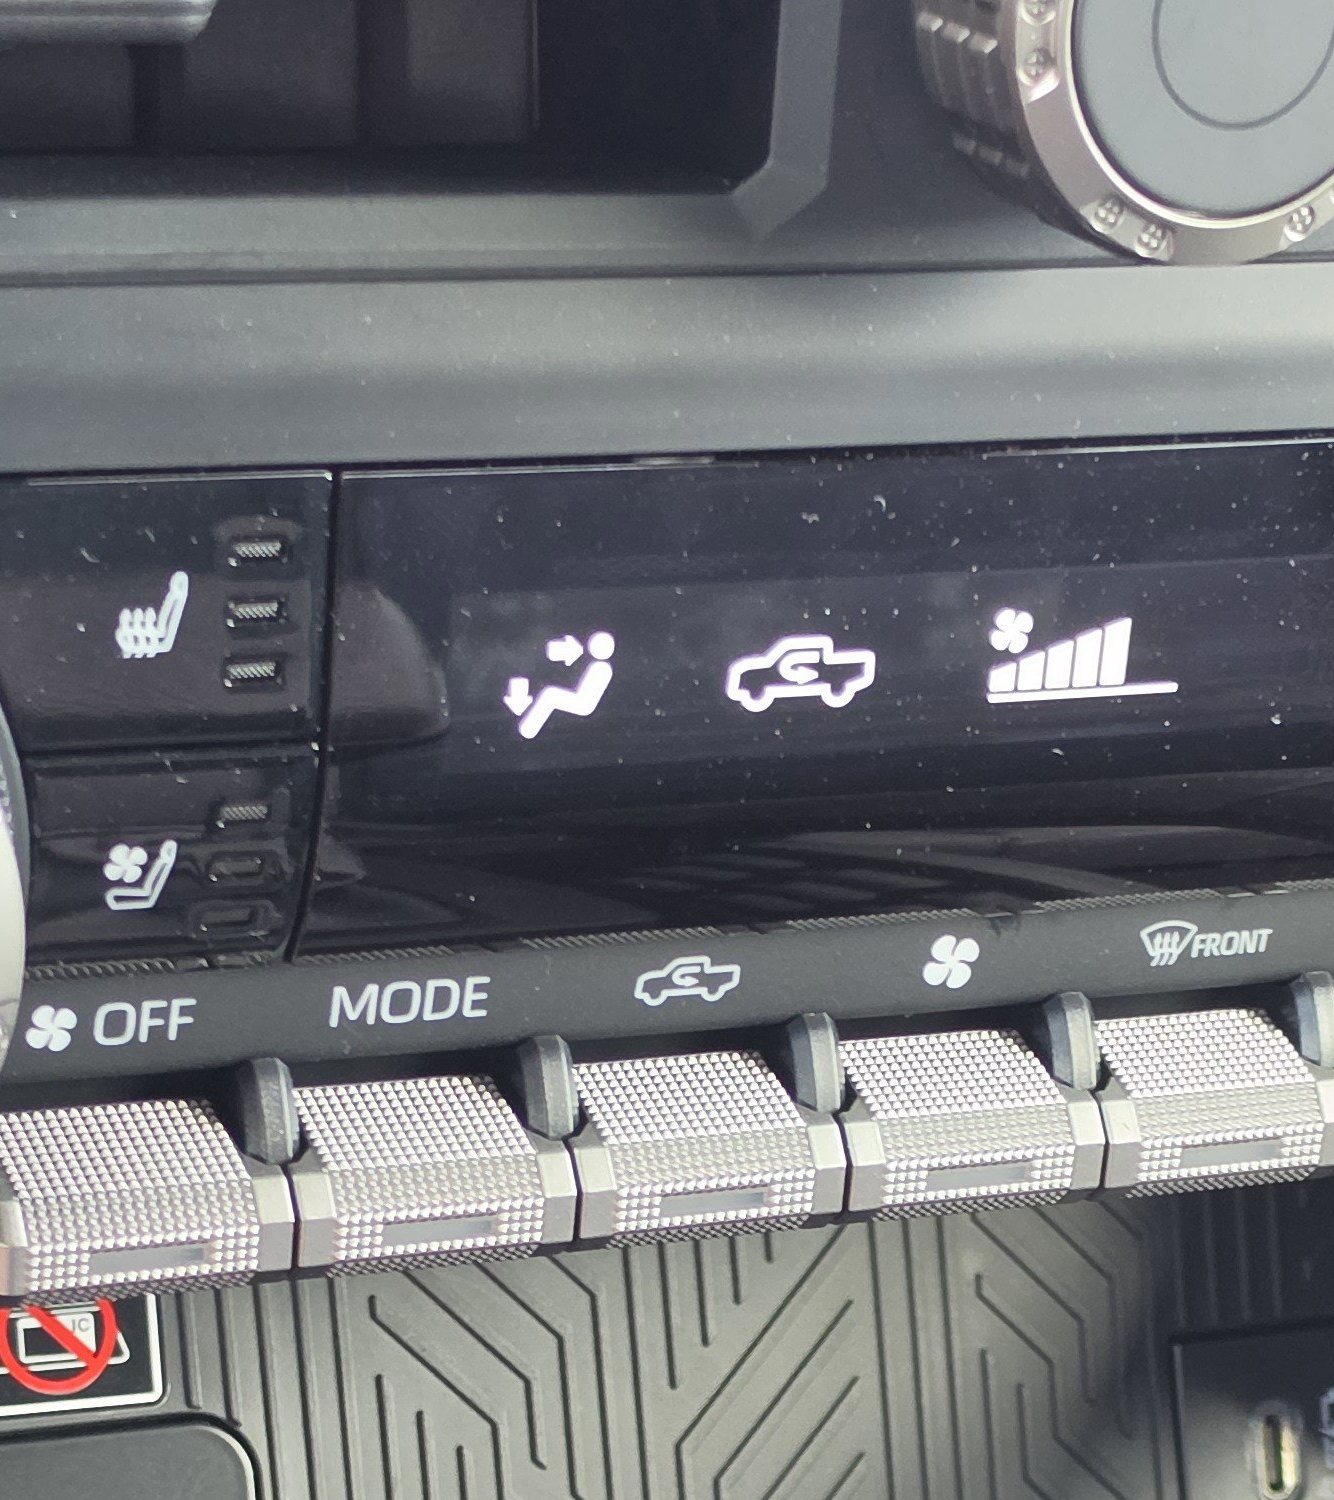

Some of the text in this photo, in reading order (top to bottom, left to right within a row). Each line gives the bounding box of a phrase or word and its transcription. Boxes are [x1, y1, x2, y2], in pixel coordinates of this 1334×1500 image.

[1191, 926, 1273, 961] FRONT
[92, 997, 198, 1046] OFF
[327, 975, 492, 1028] MODE
